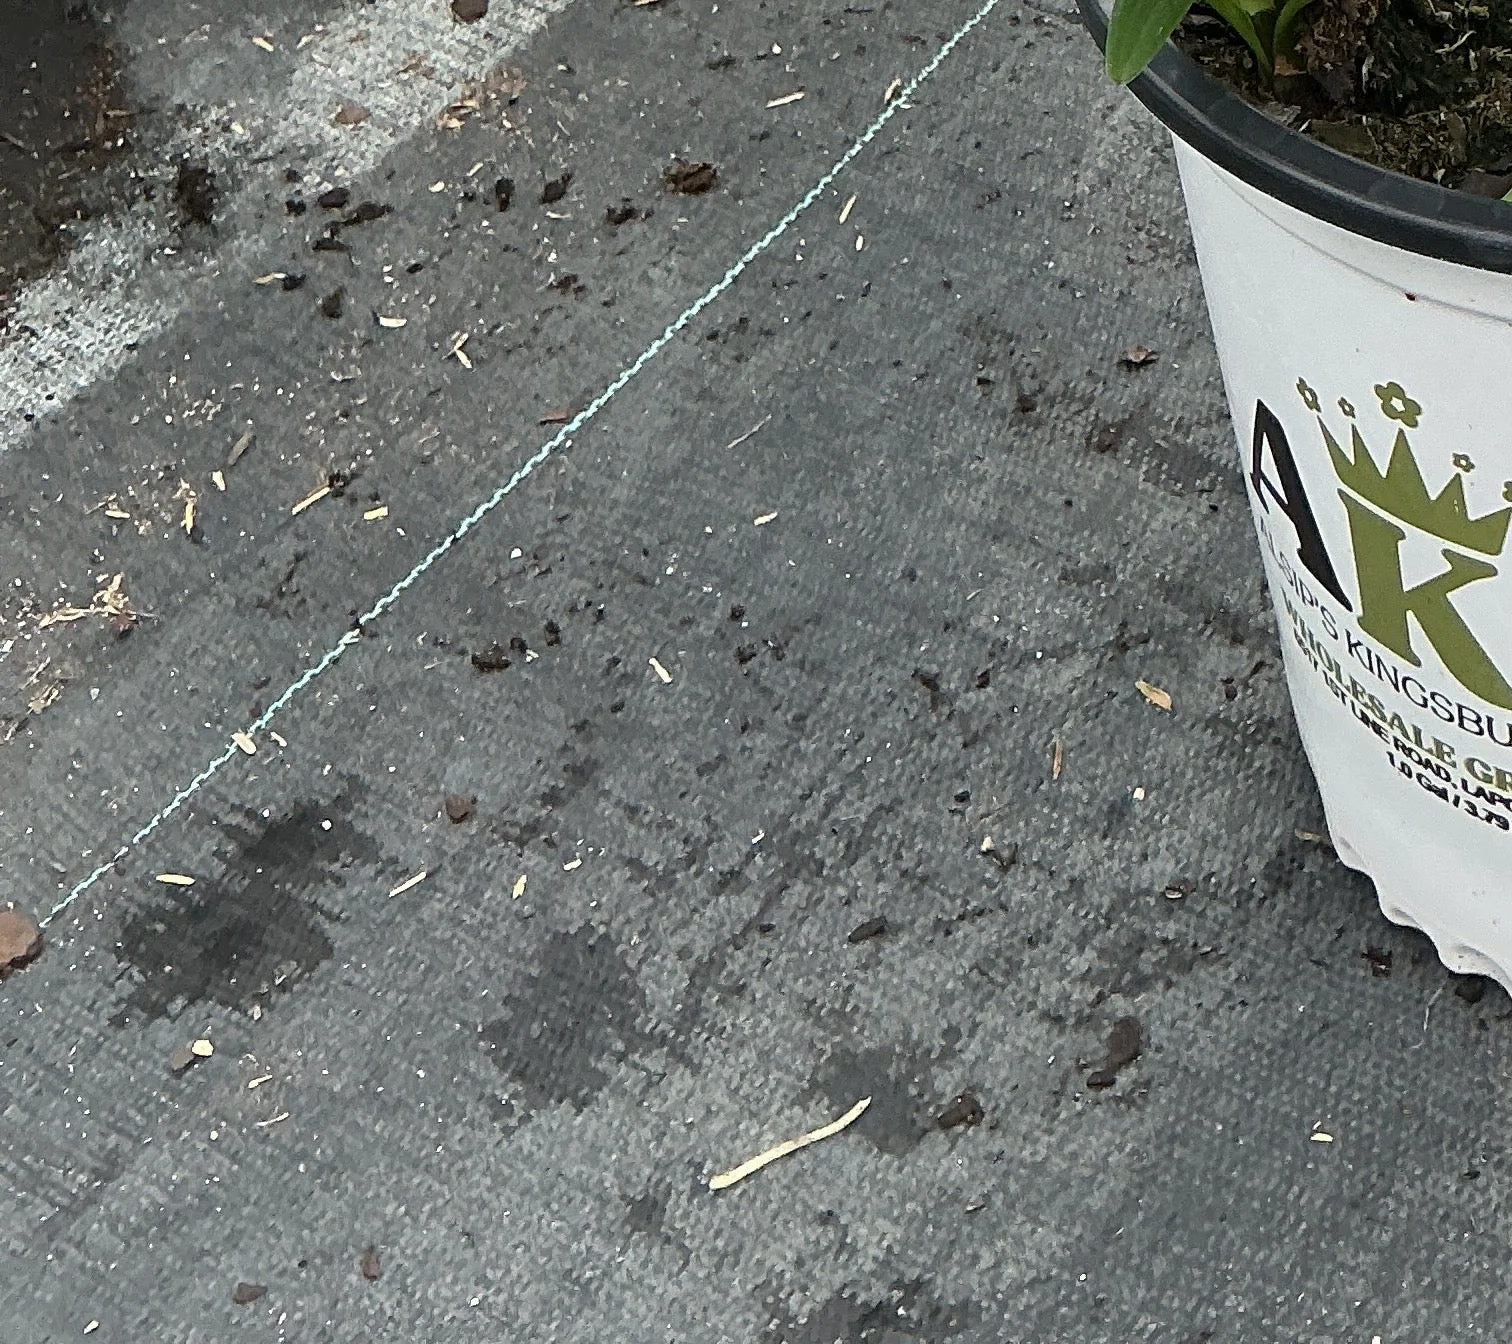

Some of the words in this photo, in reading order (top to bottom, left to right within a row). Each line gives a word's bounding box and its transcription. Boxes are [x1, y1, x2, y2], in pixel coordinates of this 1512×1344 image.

[1280, 585, 1457, 770] WHOLESALE
[1351, 701, 1390, 745] LINE
[1463, 800, 1510, 831] 3.79
